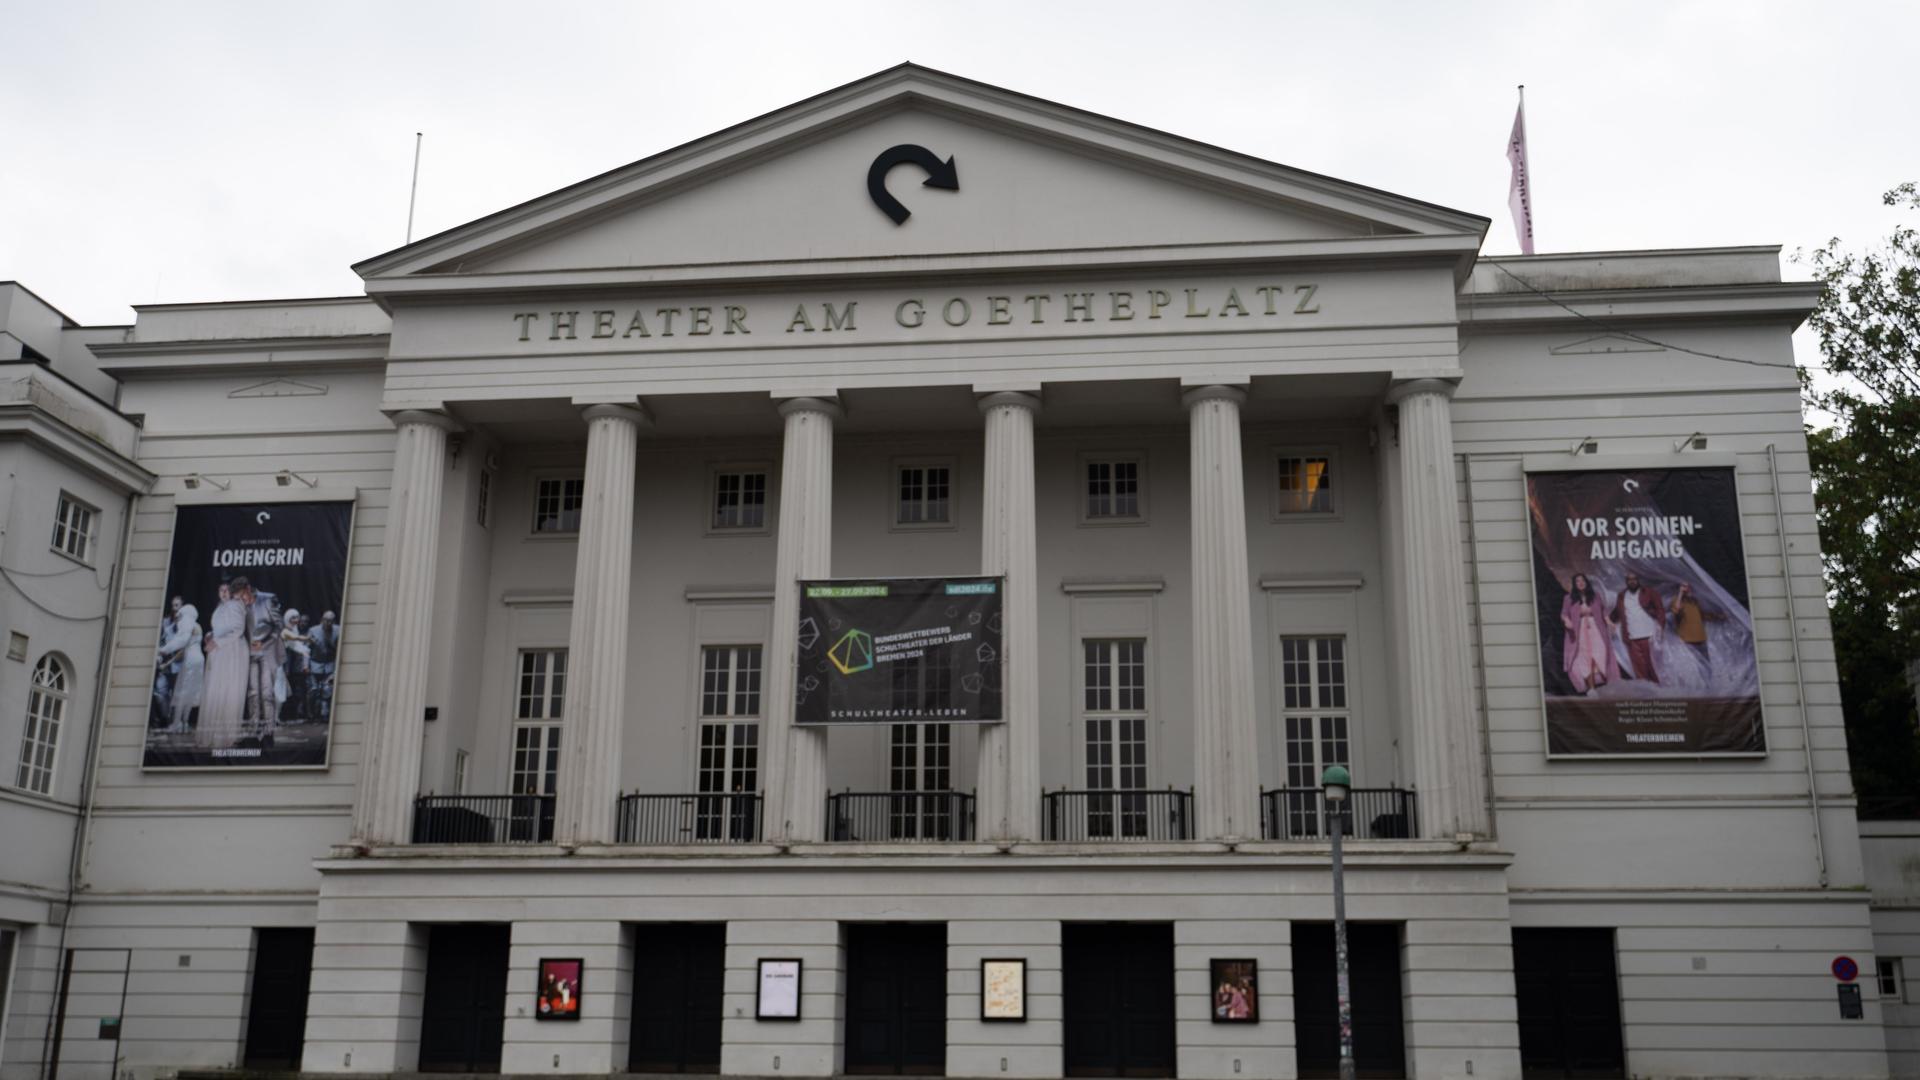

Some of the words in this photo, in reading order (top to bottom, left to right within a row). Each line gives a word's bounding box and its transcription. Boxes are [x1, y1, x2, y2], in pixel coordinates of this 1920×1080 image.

[514, 305, 751, 341] THEATER
[786, 302, 858, 332] AM
[895, 284, 1321, 328] GOETHEPLATZ
[1566, 518, 1609, 537] VOR
[1615, 515, 1703, 536] SONNEN-
[212, 547, 305, 567] LOHENGRIN
[1590, 539, 1684, 560] AUFGANG
[874, 626, 951, 644] BUNDESWETTBEWERB
[875, 639, 929, 653] SCHULTHEATER
[929, 637, 944, 646] DER
[944, 632, 972, 644] LÄNDER
[876, 651, 906, 663] BREMEN
[906, 649, 924, 659] 2024
[831, 708, 967, 718] SCHULTHEATER.LEBEN
[1625, 733, 1685, 742] THEATERBREMEN
